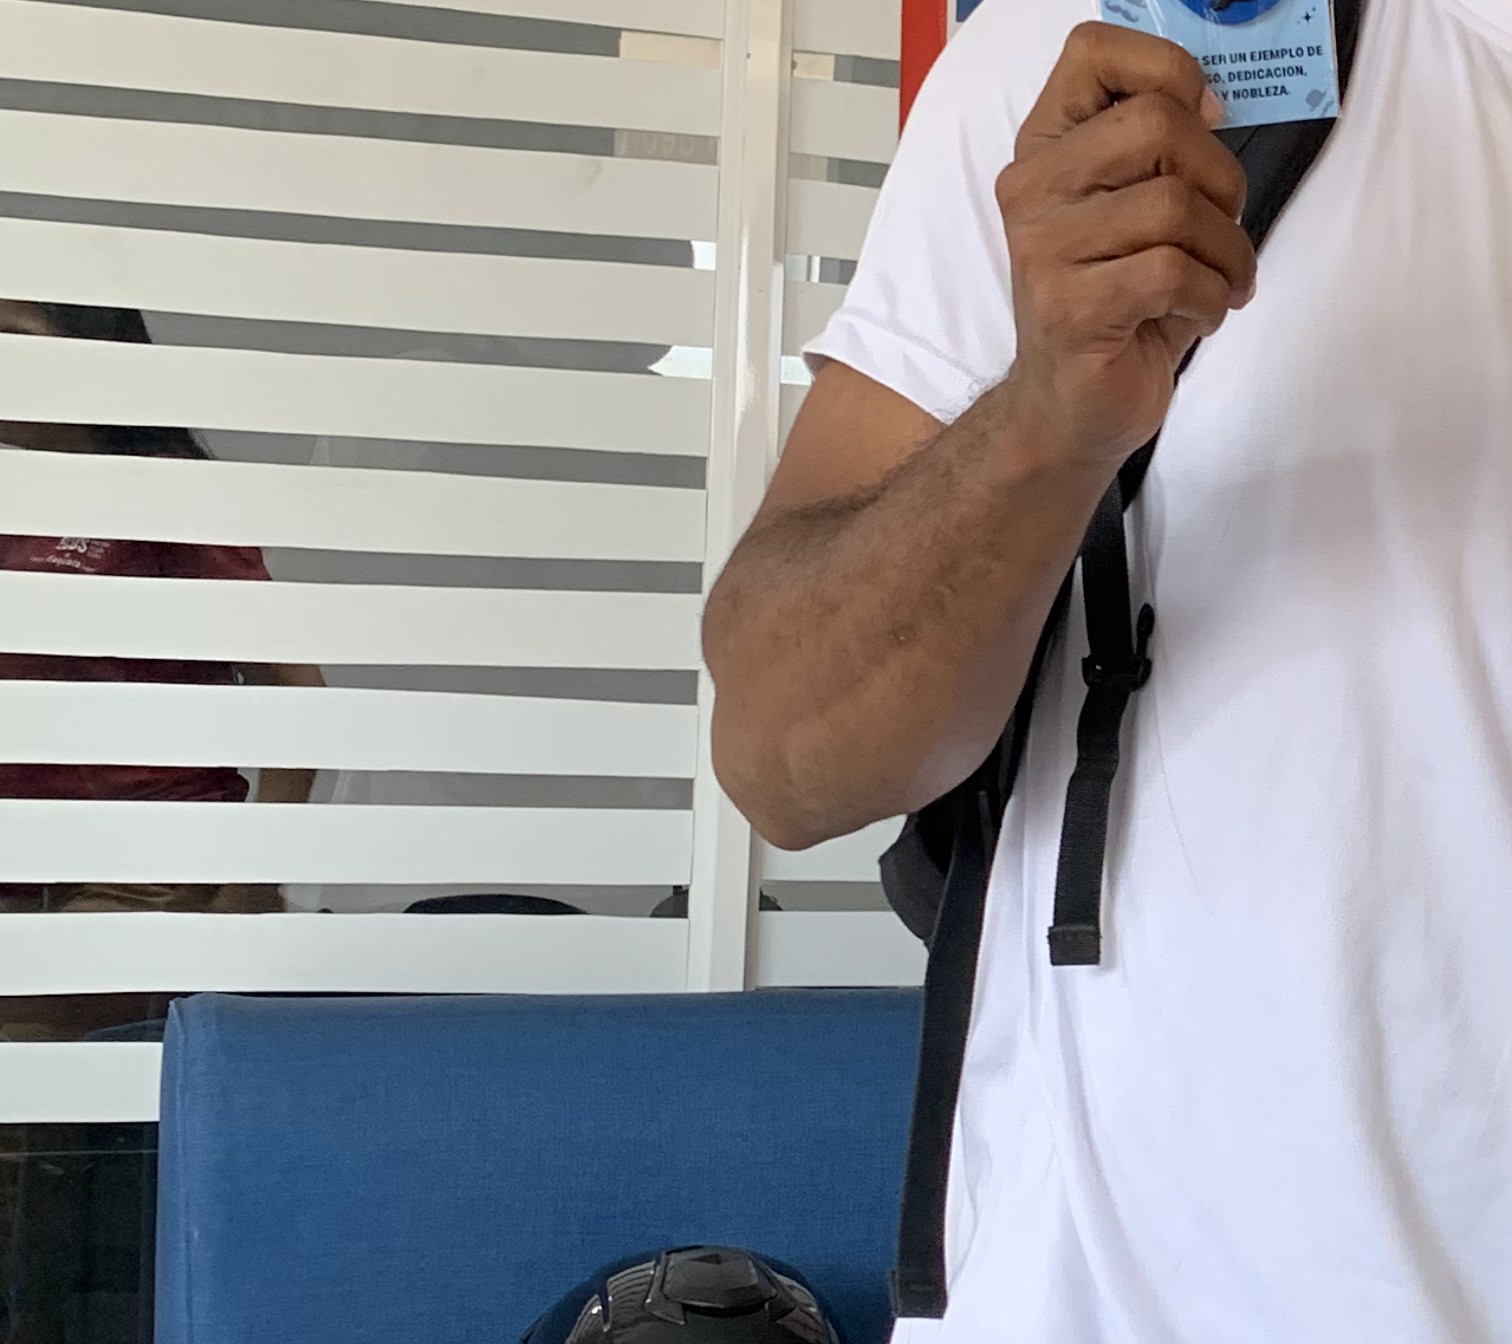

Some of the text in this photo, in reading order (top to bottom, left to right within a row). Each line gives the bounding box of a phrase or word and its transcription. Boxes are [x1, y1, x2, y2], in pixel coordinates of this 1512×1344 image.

[1202, 44, 1323, 66] SER UN EJEMPLO DE
